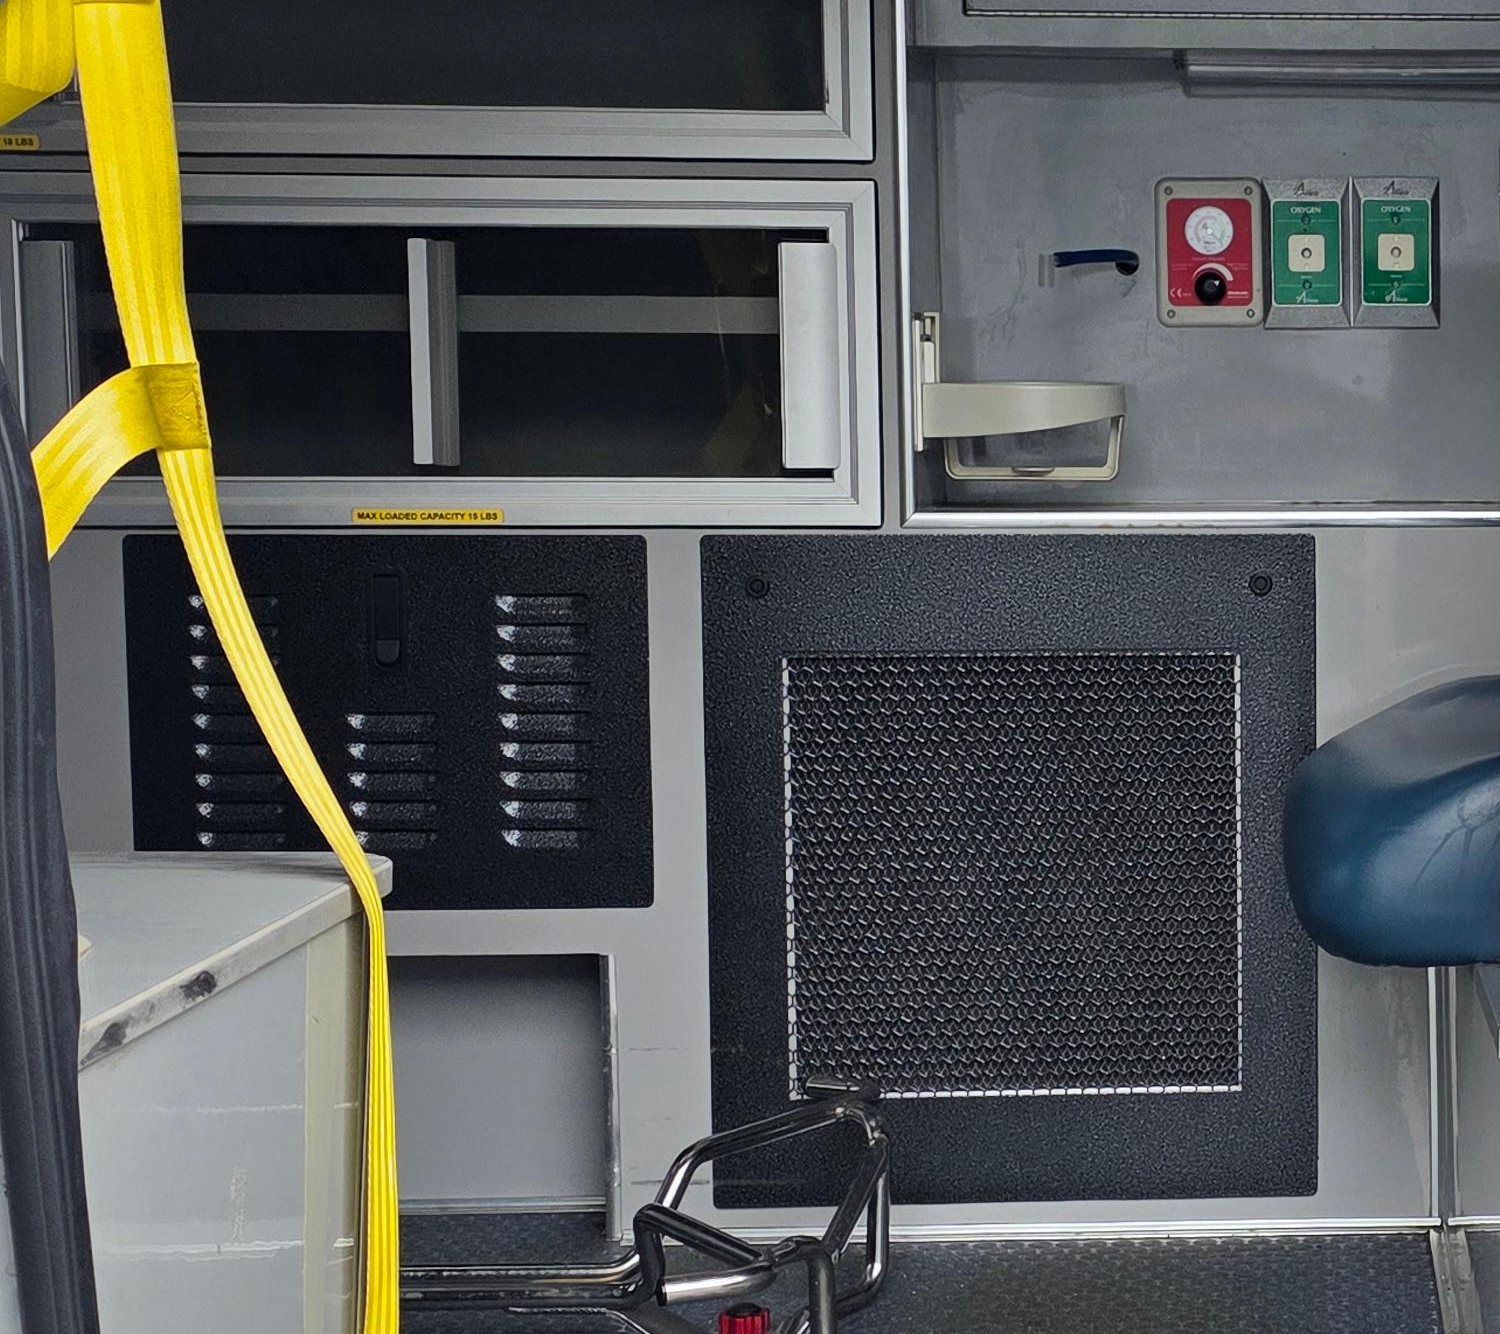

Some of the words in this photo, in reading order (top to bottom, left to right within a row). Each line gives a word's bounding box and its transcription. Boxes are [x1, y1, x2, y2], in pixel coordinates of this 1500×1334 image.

[15, 137, 34, 147] LBS
[1290, 206, 1322, 214] OXYGEN
[1380, 205, 1411, 213] OXYGEN
[357, 512, 378, 521] MAX
[379, 512, 418, 521] LOADED
[419, 512, 466, 521] CAPACITY
[468, 512, 479, 521] 15
[480, 512, 498, 521] LBS
